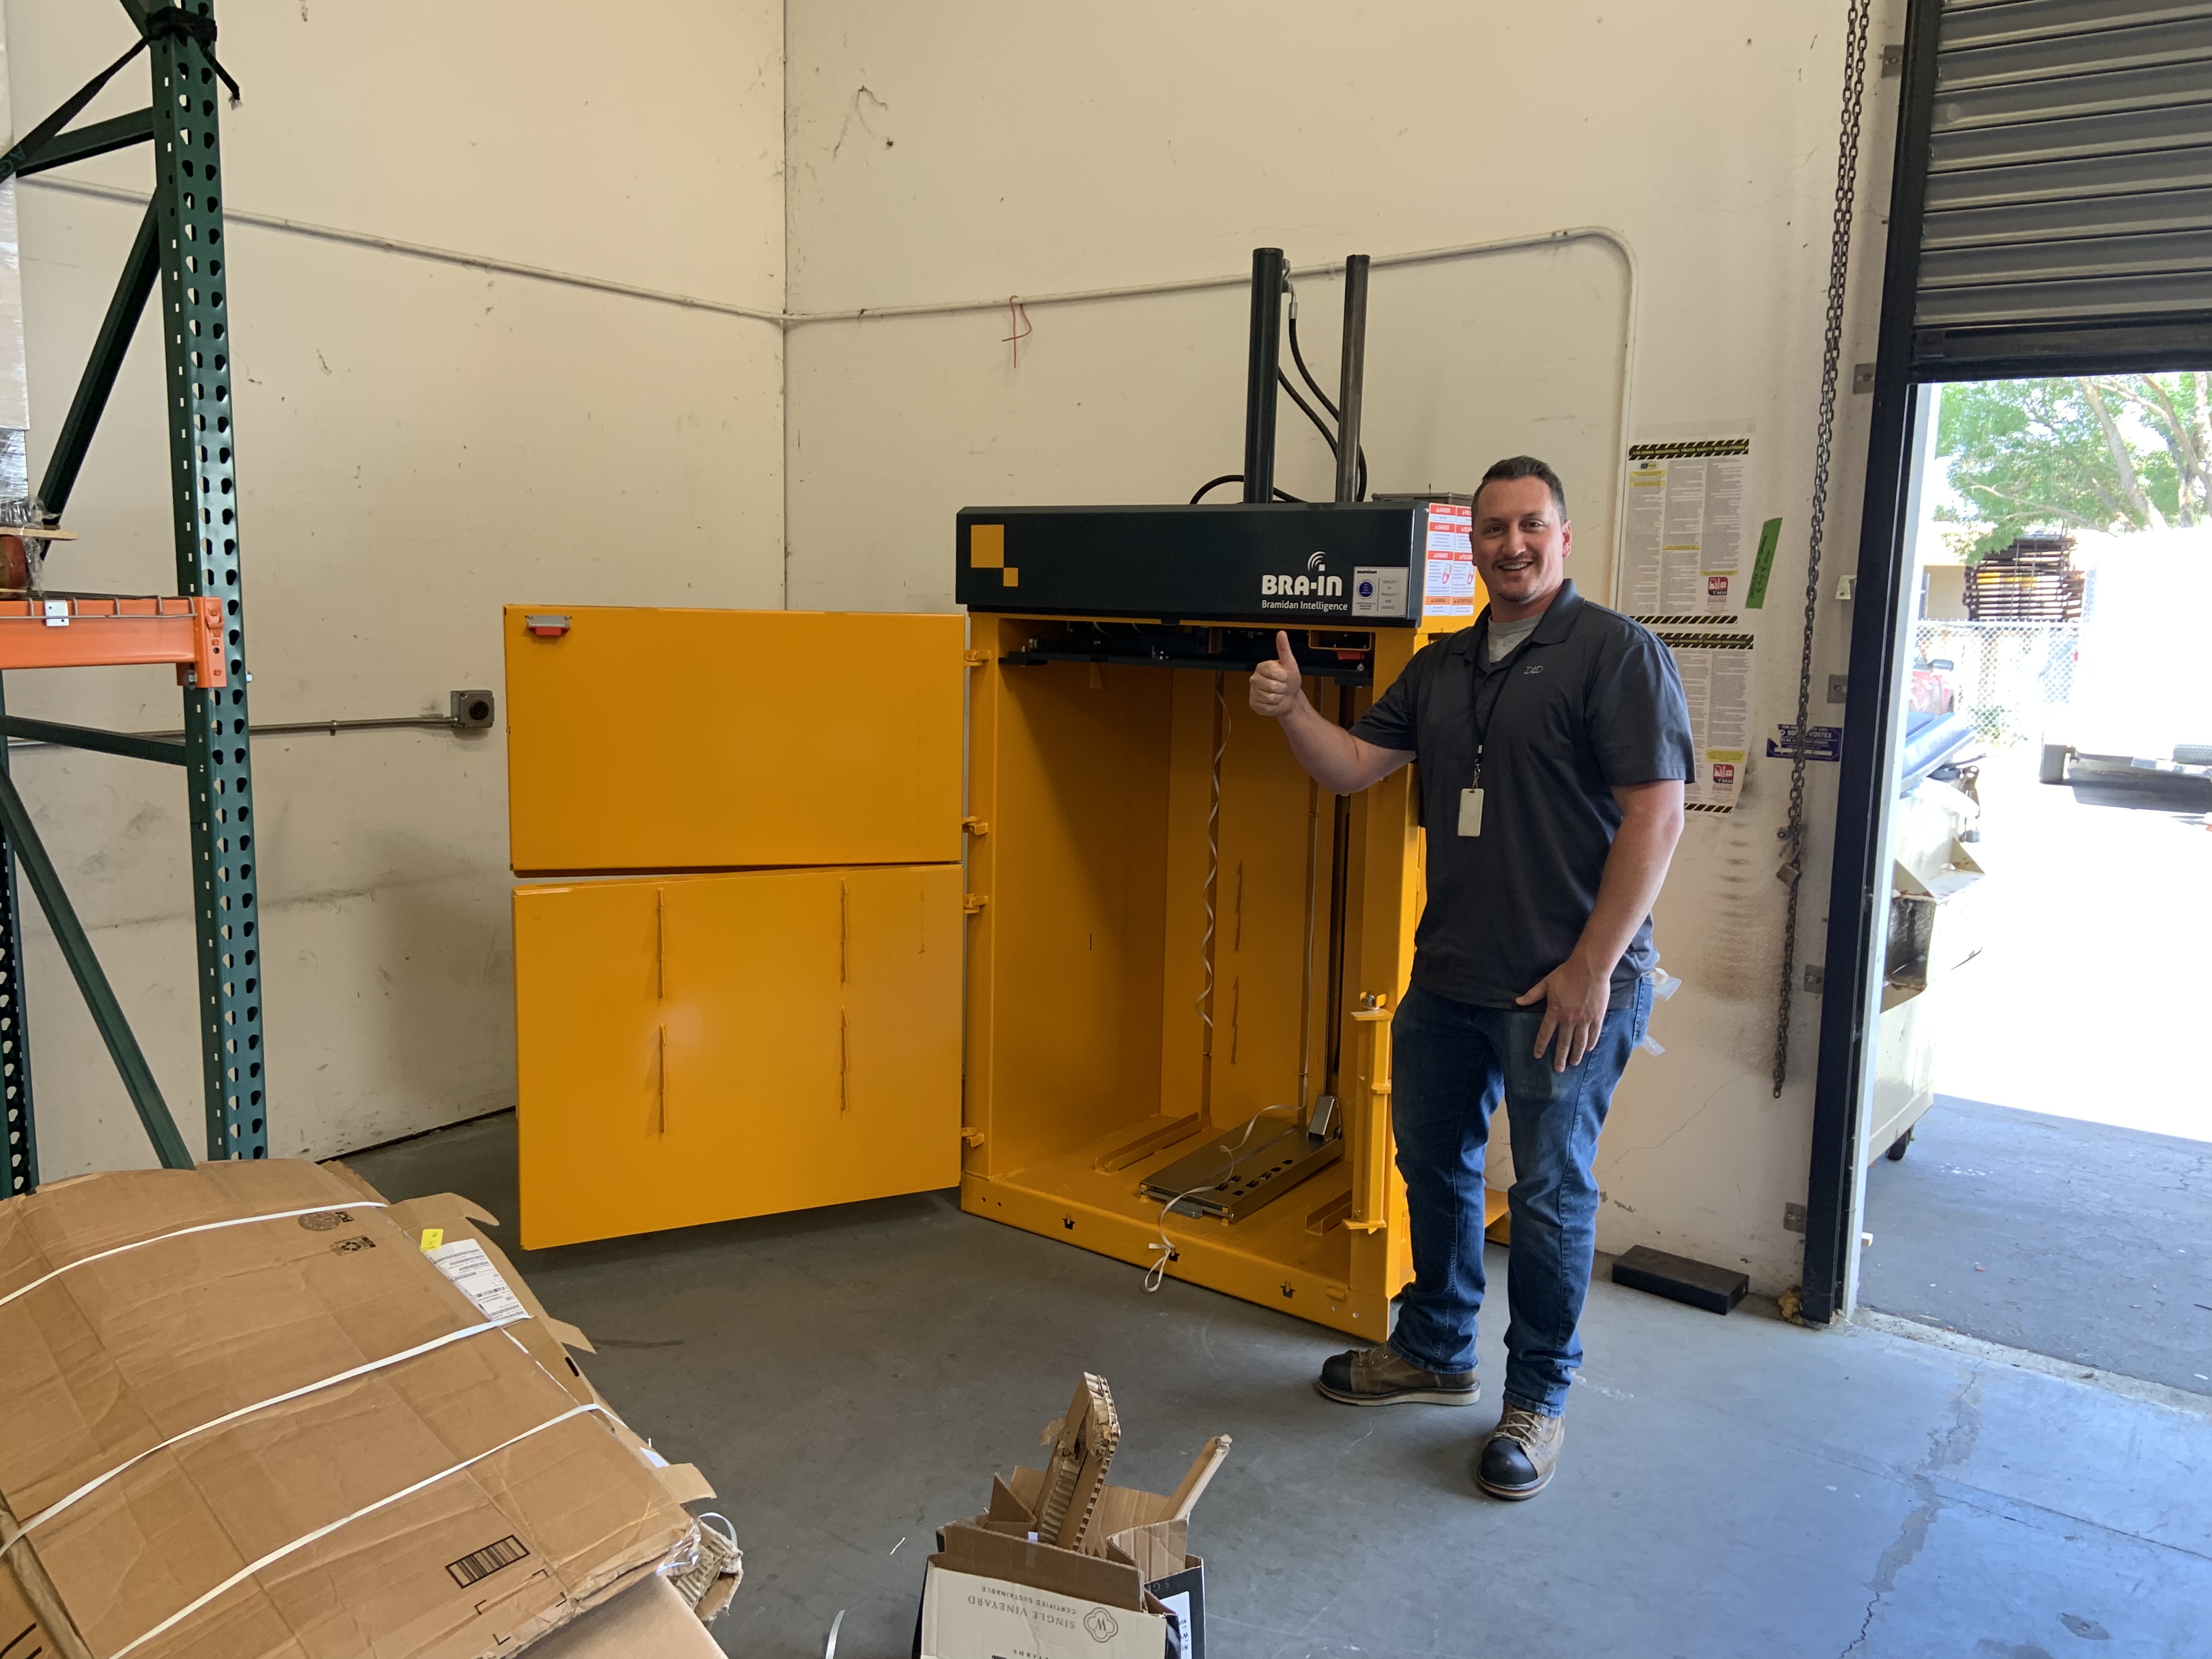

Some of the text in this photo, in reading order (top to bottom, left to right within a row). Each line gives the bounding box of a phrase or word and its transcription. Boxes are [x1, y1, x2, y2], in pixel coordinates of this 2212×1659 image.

[1262, 600, 1299, 609] Bramidan
[1301, 601, 1348, 612] Intelligence
[981, 1586, 1076, 1615] CERTIFIED SUSTAINABLE
[968, 1595, 1076, 1629] SINGLE VINEYARD
[1096, 1618, 1107, 1632] W
